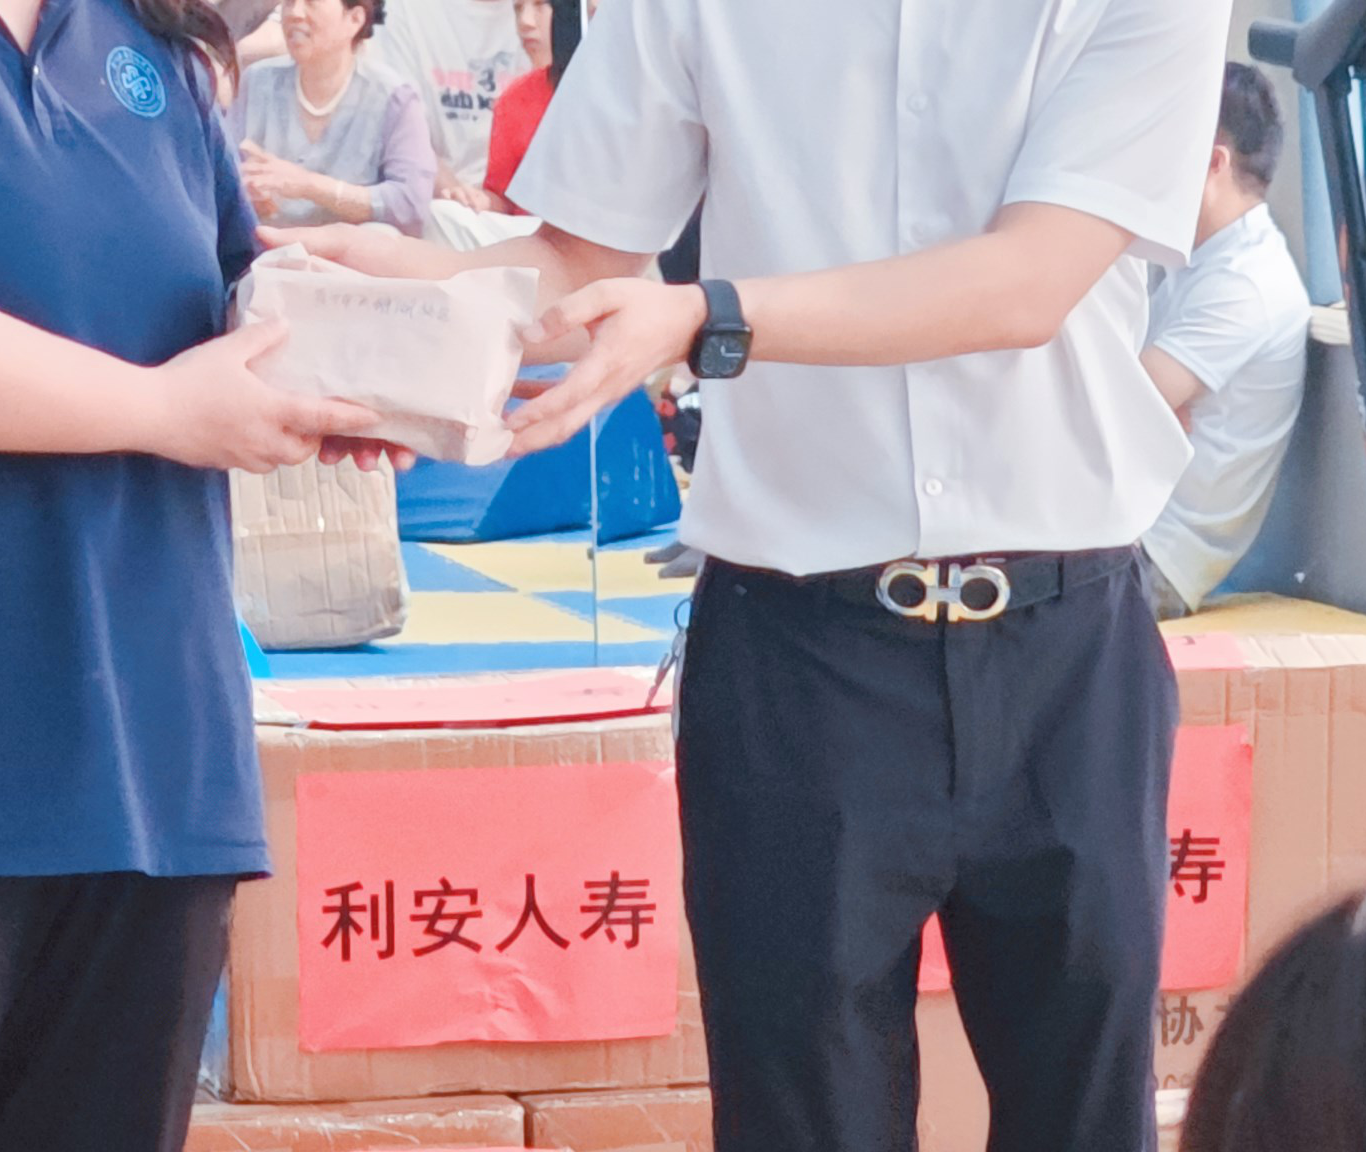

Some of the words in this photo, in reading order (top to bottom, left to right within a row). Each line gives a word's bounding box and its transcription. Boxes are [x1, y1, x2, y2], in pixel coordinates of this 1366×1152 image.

[1169, 828, 1226, 904] 寿
[321, 870, 657, 962] 利安人寿
